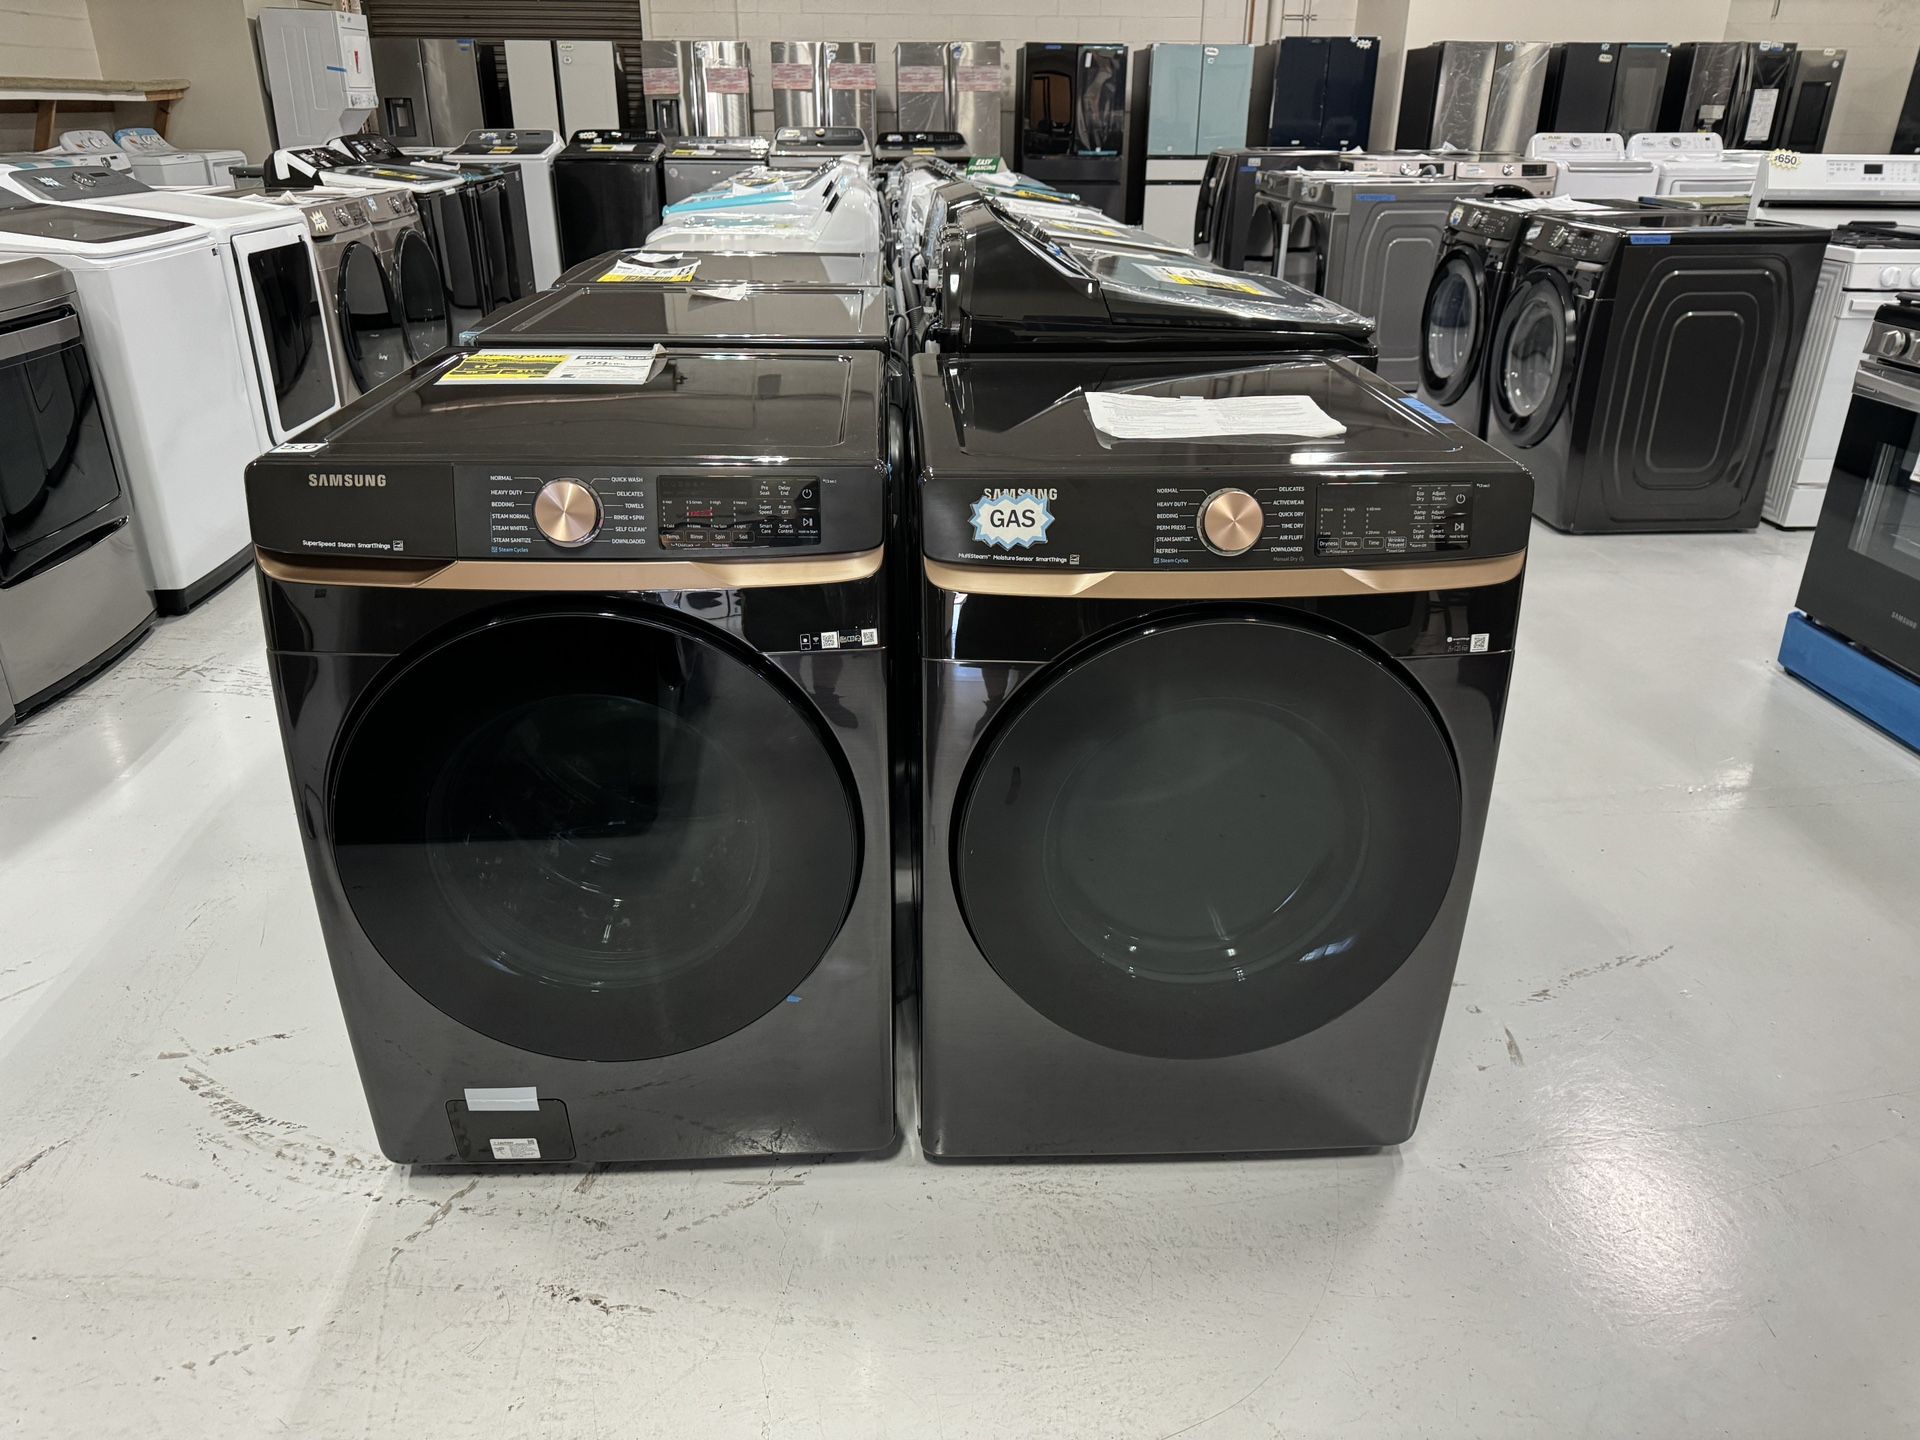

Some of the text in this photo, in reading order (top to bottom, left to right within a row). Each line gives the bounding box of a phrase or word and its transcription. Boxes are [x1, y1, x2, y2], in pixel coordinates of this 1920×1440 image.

[308, 473, 387, 487] SAMSUNG
[989, 509, 1036, 528] GAS
[302, 539, 336, 548] SuperSpeed
[357, 542, 391, 550] SmartThings
[1035, 556, 1067, 564] SmartThings
